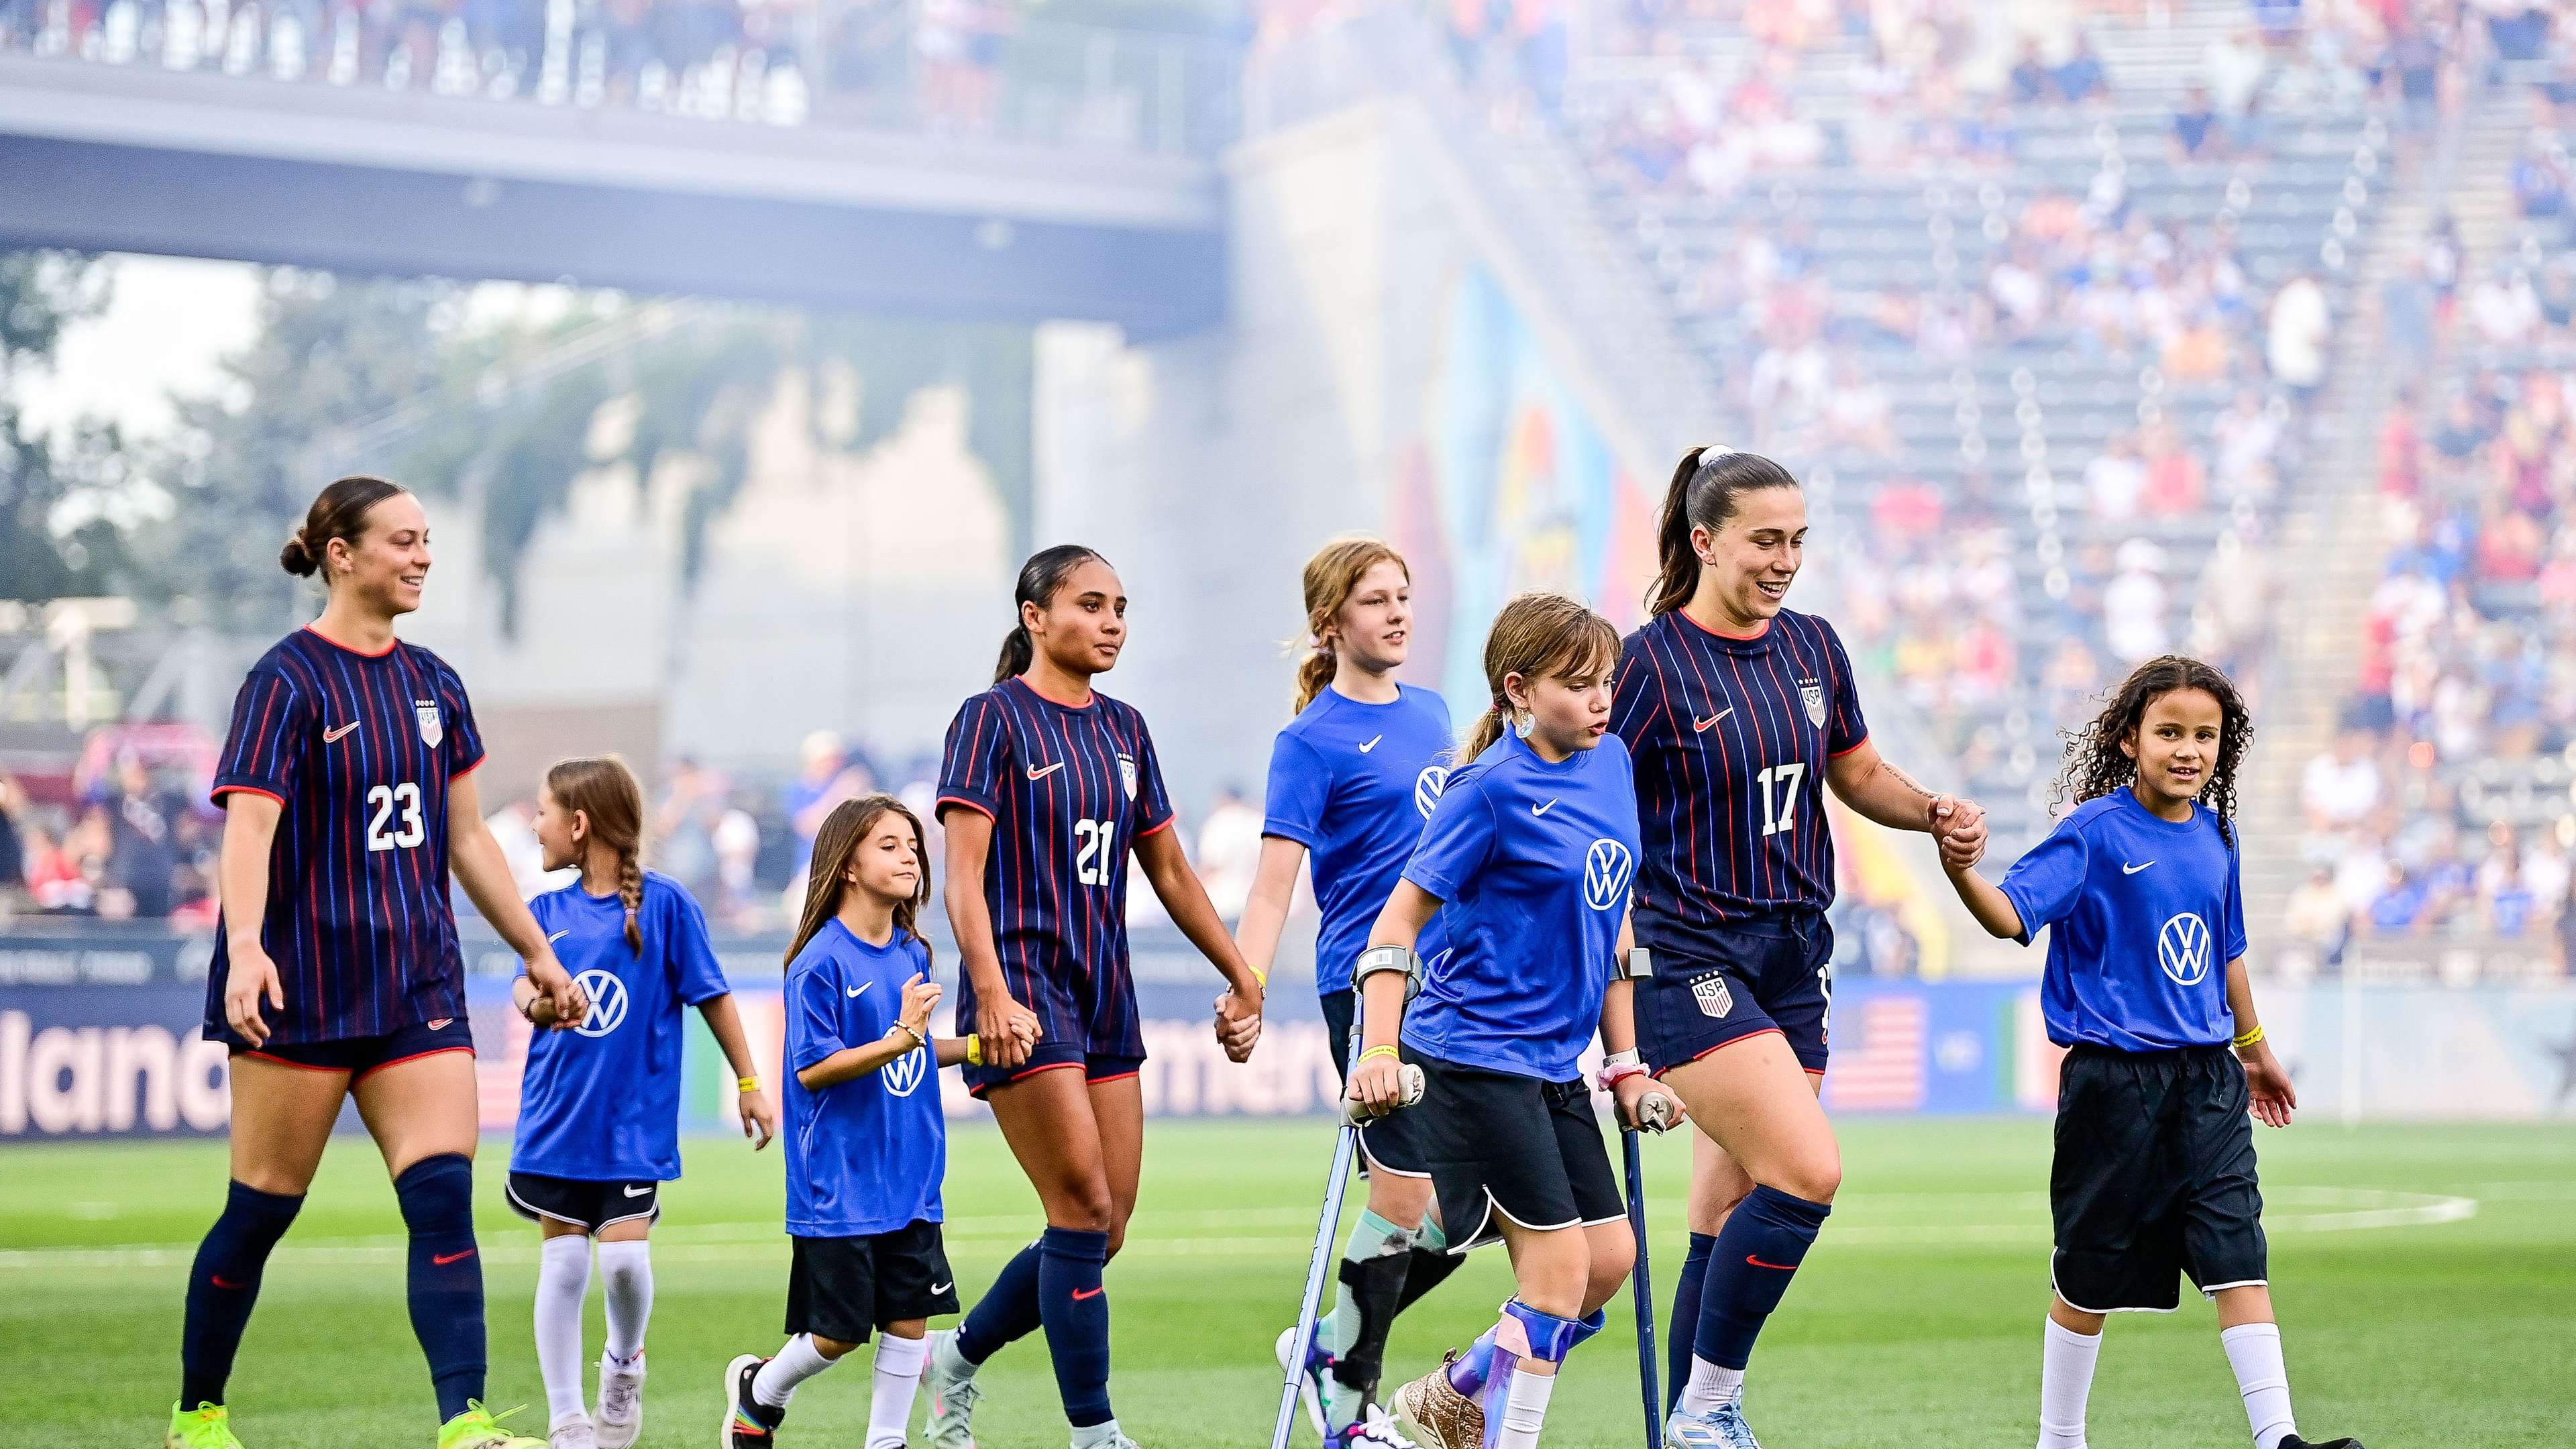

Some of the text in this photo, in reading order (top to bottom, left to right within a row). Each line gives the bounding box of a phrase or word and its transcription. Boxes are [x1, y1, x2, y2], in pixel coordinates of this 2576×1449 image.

[1803, 689, 1820, 704] USA
[367, 782, 425, 851] 23
[1757, 762, 1805, 837] 17
[1074, 818, 1114, 886] 21
[1583, 839, 1632, 911] VW
[2157, 912, 2211, 986] VW
[572, 969, 629, 1038] VW
[1695, 980, 1723, 997] USA
[881, 1034, 926, 1097] W
